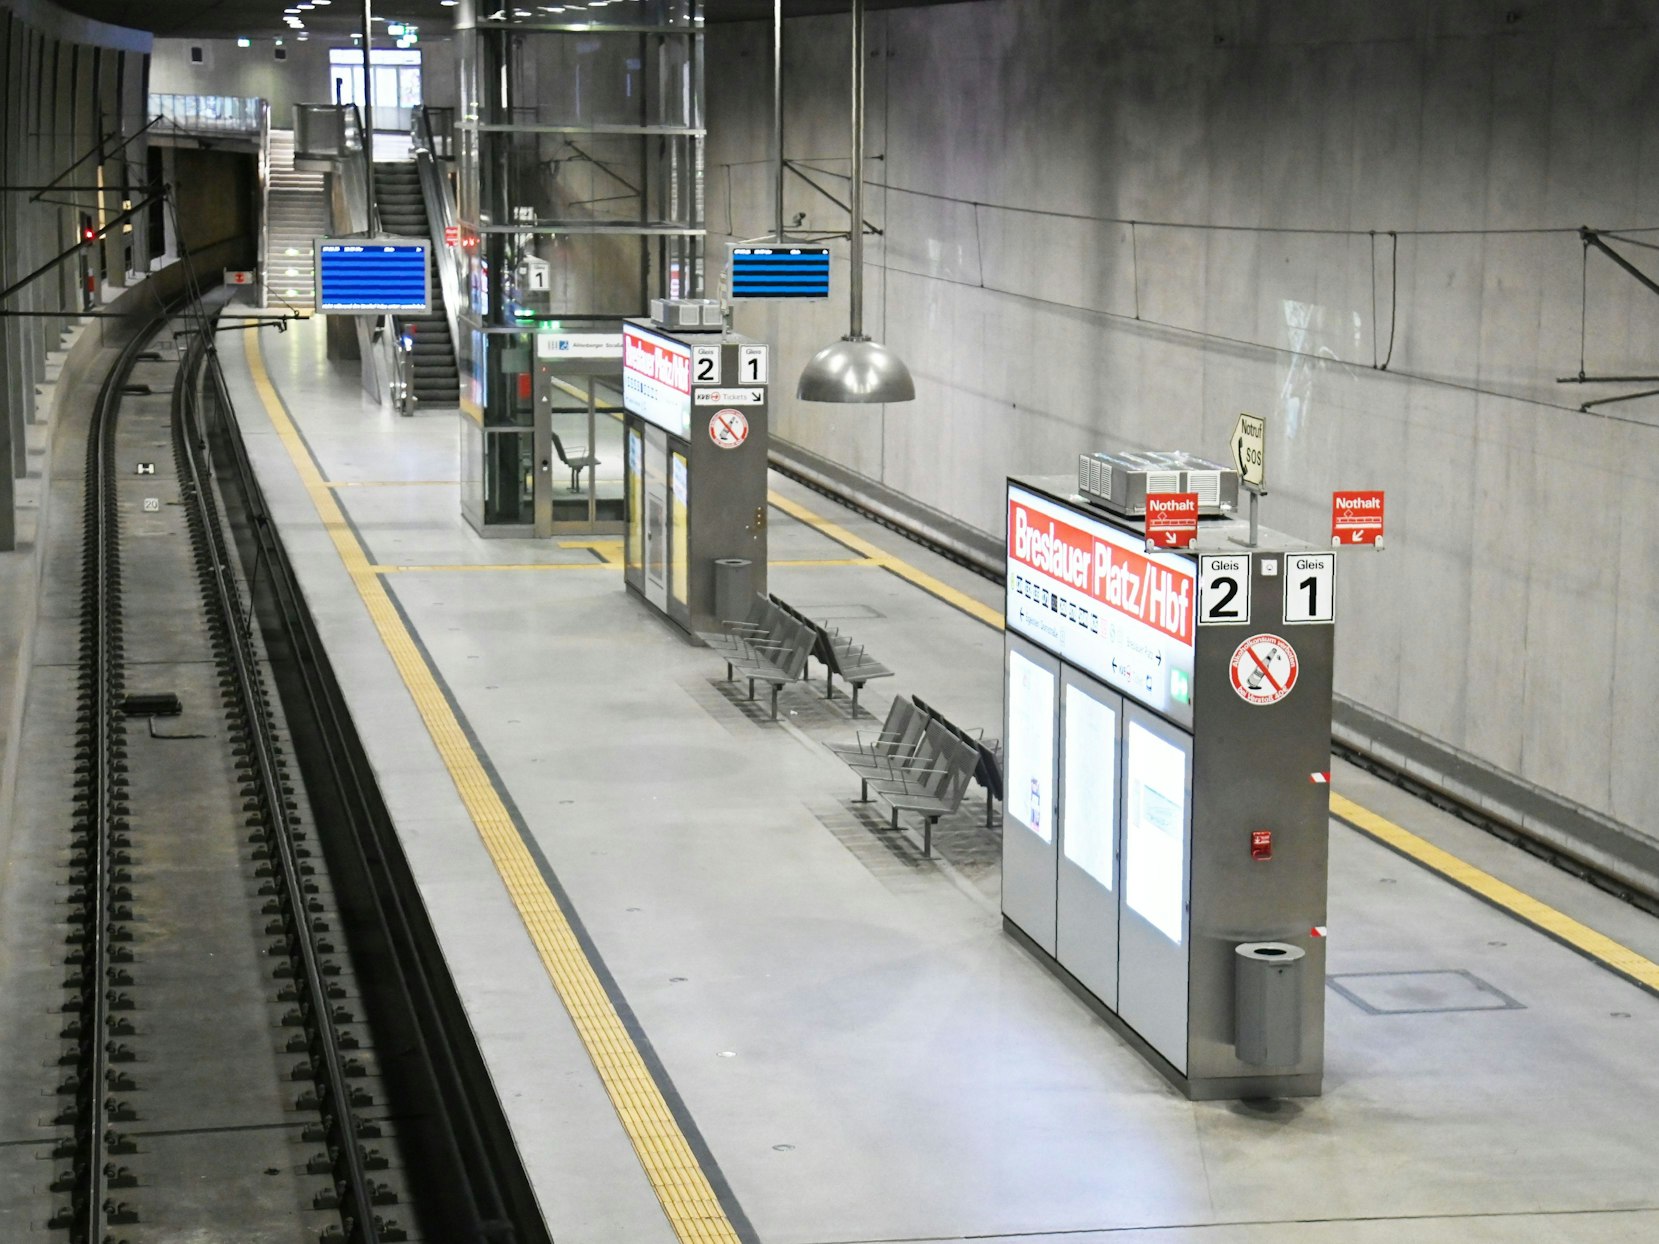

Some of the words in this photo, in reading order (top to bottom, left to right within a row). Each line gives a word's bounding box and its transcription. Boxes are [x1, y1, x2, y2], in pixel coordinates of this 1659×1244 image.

[536, 272, 543, 287] 1
[697, 358, 714, 380] 2
[748, 358, 757, 380] 1
[1241, 418, 1263, 439] Notruf
[1246, 447, 1262, 466] SOS
[1149, 499, 1195, 511] Nothalt
[1335, 497, 1380, 509] Nothalt
[1015, 507, 1092, 589] Breslauer
[1094, 541, 1189, 638] Platz/Hbf
[1211, 560, 1239, 571] Gleis
[1296, 559, 1324, 570] Gleis
[1209, 576, 1238, 617] 2
[1299, 576, 1317, 616] 1
